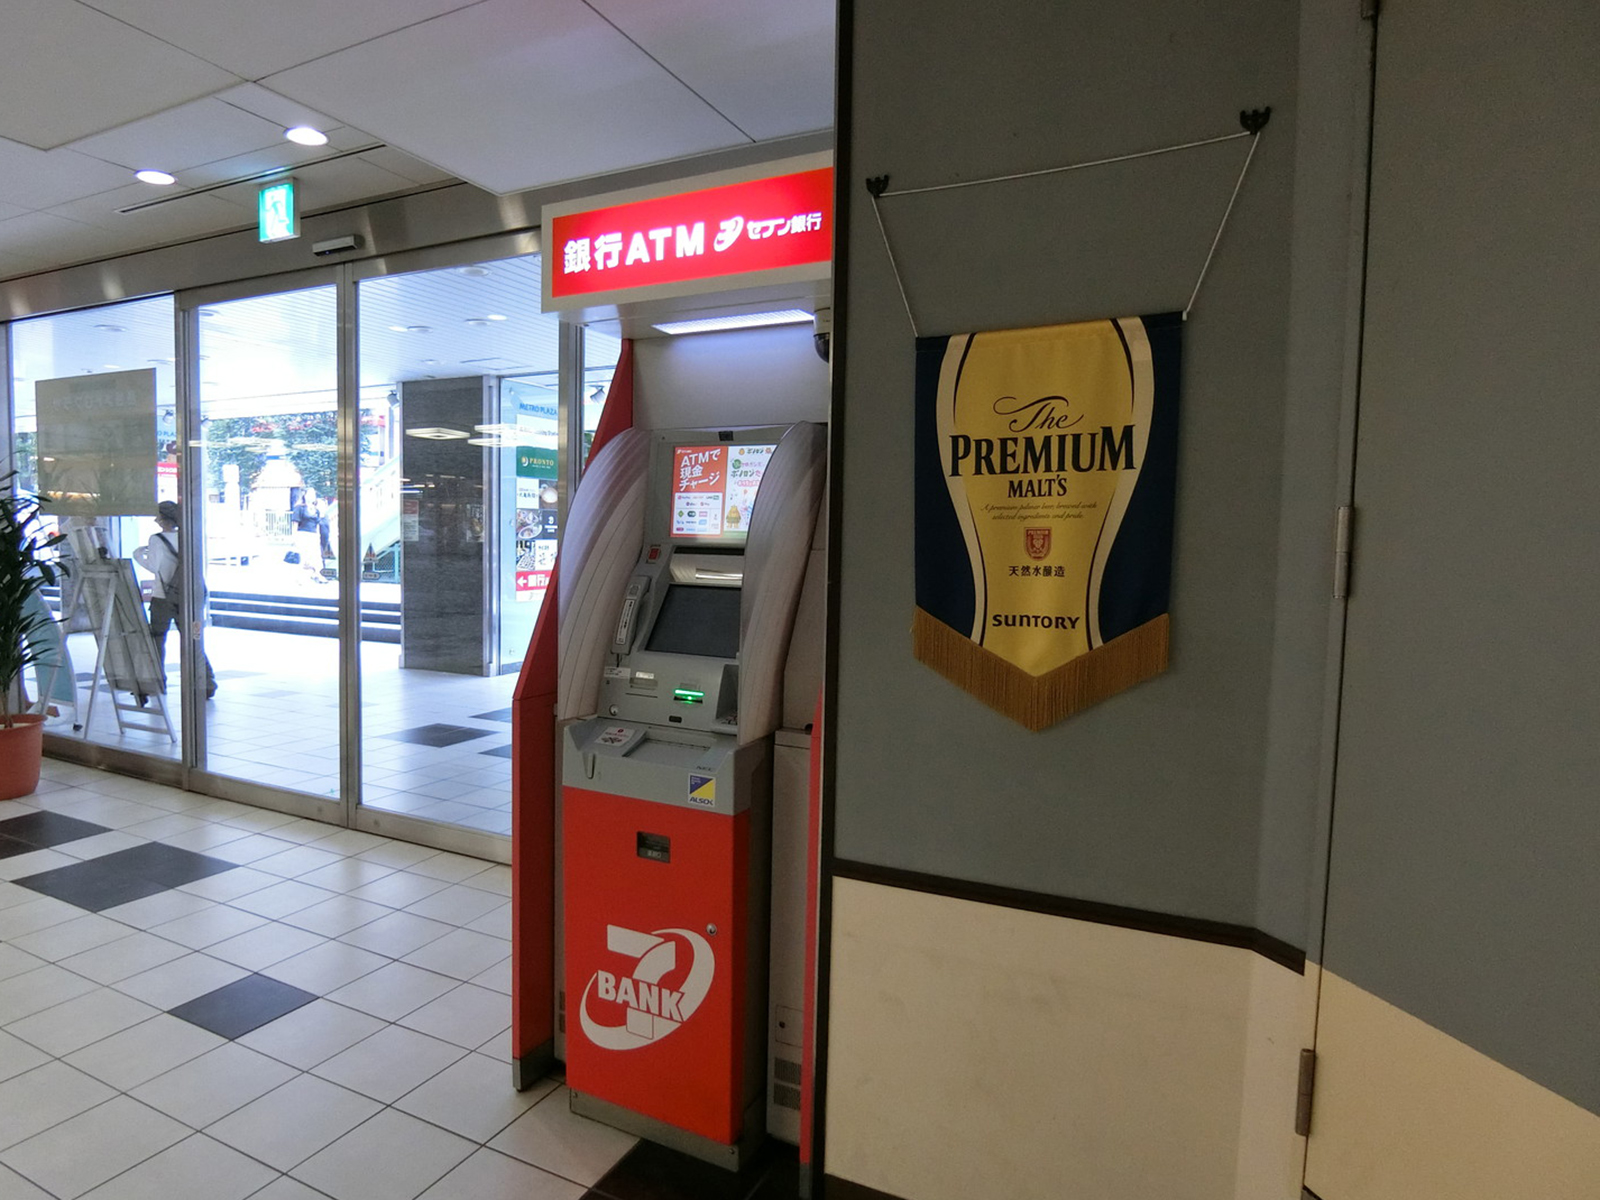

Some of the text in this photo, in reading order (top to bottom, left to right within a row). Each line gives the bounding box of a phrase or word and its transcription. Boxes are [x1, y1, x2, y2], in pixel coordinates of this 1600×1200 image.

[563, 222, 705, 274] 銀行ATM
[747, 212, 822, 240] セブン銀行
[519, 403, 557, 415] METRO PLAZA
[993, 396, 1084, 432] The
[681, 449, 720, 467] ATMで
[949, 425, 1136, 477] PREMIUM
[530, 457, 554, 466] PRONTO
[679, 471, 720, 491] チャージ
[680, 465, 703, 479] 現金
[1008, 474, 1067, 498] MALT'S
[1009, 565, 1065, 577] 天然水醸造
[992, 614, 1080, 629] SUNTORY
[690, 796, 714, 806] ALSOK
[598, 969, 684, 1022] BANK
